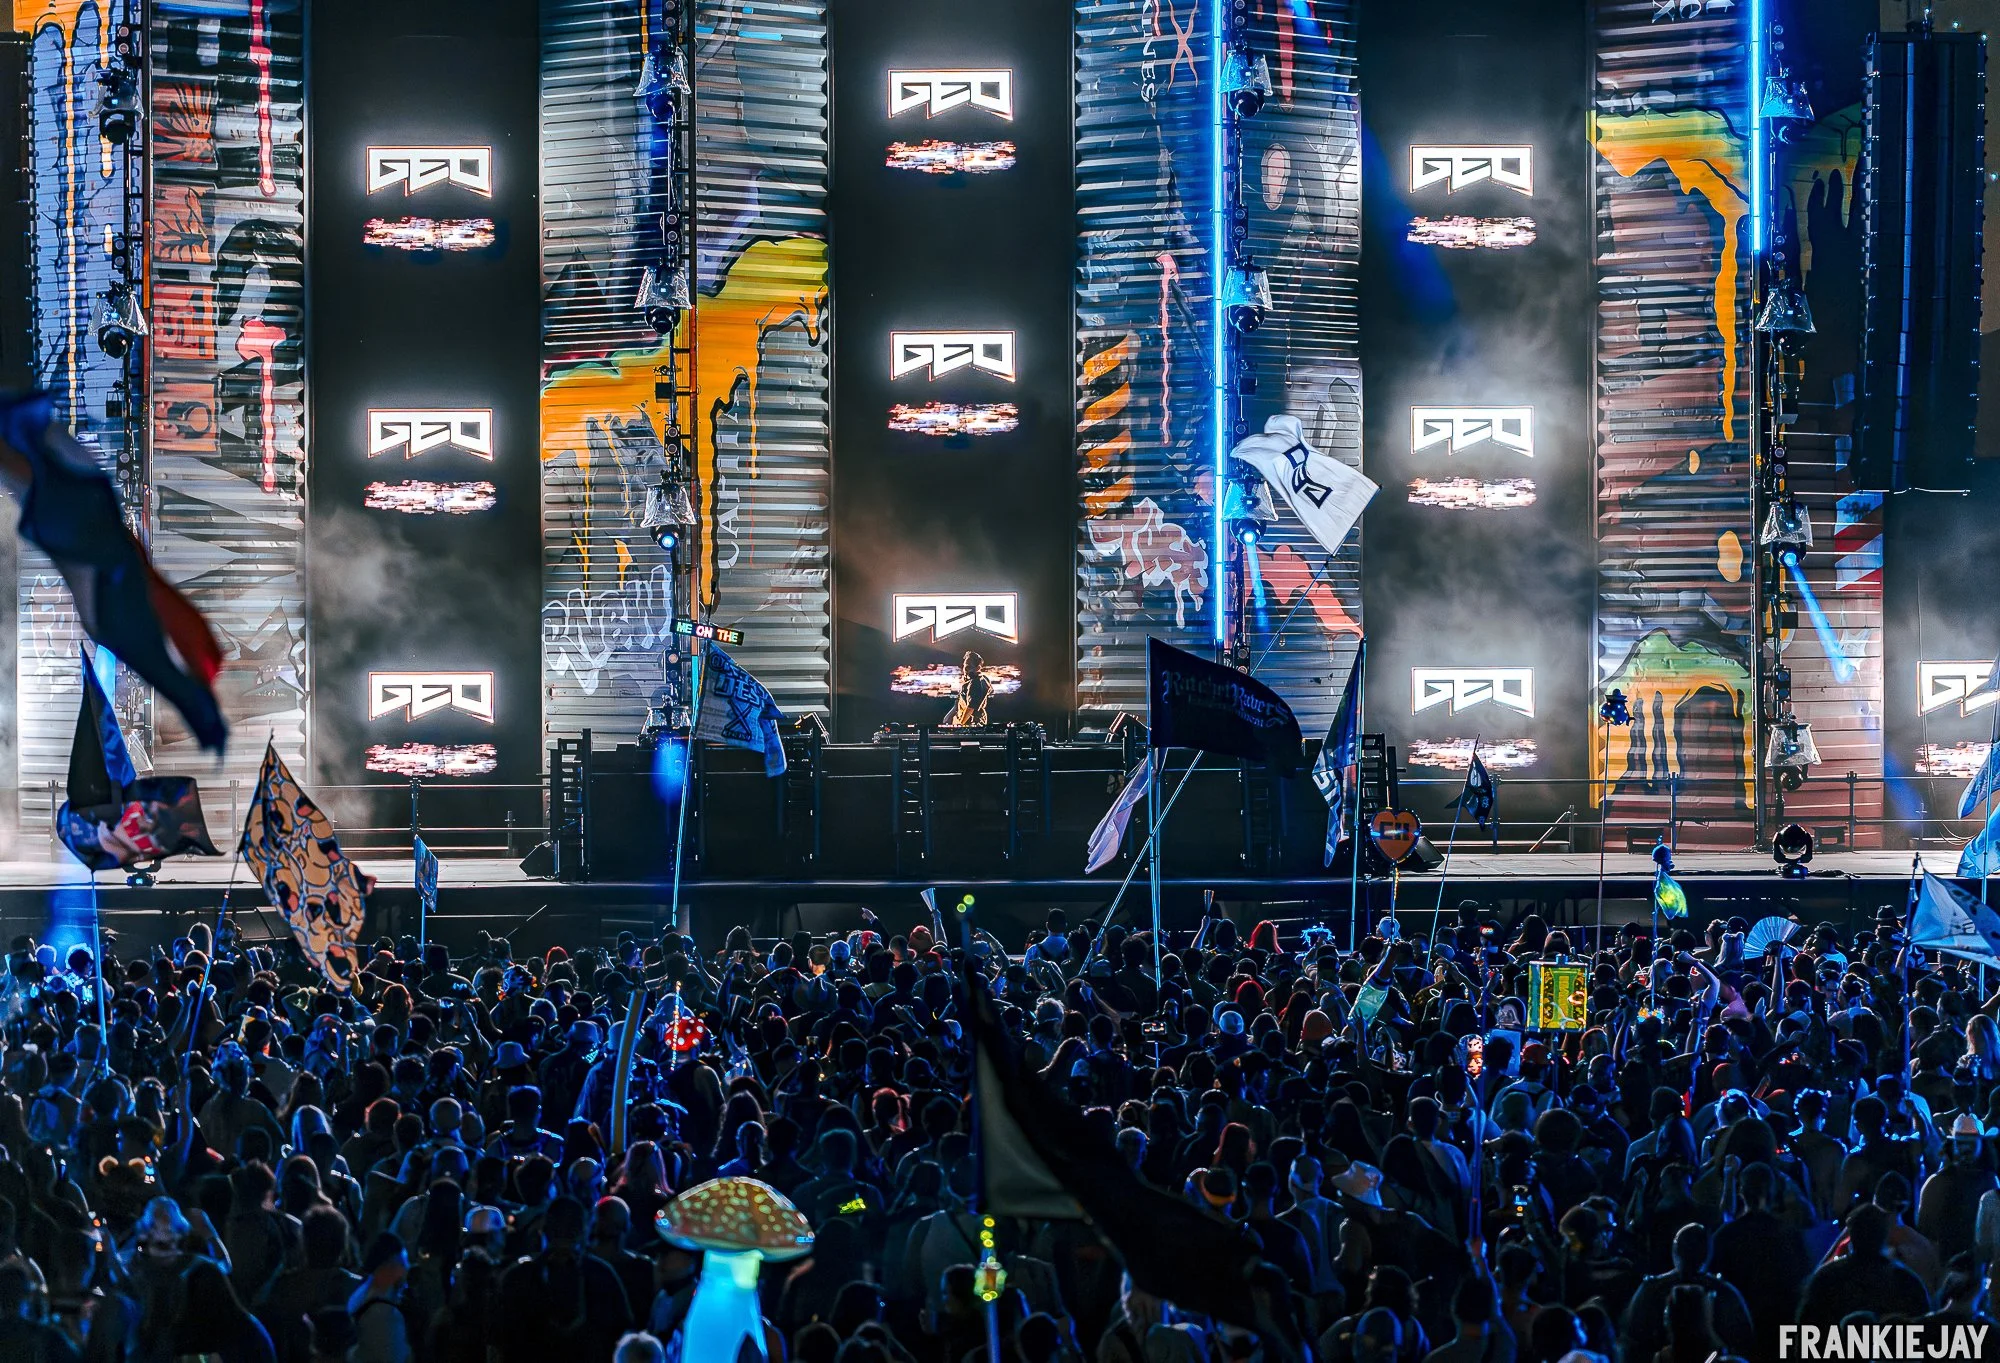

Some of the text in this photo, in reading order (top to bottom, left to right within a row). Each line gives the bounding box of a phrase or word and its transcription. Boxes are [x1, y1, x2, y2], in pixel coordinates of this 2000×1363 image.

[887, 69, 1014, 121] GEO
[366, 145, 492, 197] GEO
[1409, 144, 1534, 195] GEO
[890, 330, 1016, 383] GEO
[367, 408, 493, 461] GEO
[1410, 405, 1535, 457] GEO
[695, 626, 713, 638] ON
[717, 629, 738, 643] THE
[892, 592, 1018, 644] GEO
[368, 671, 495, 724] GEO
[1410, 667, 1535, 718] GEO
